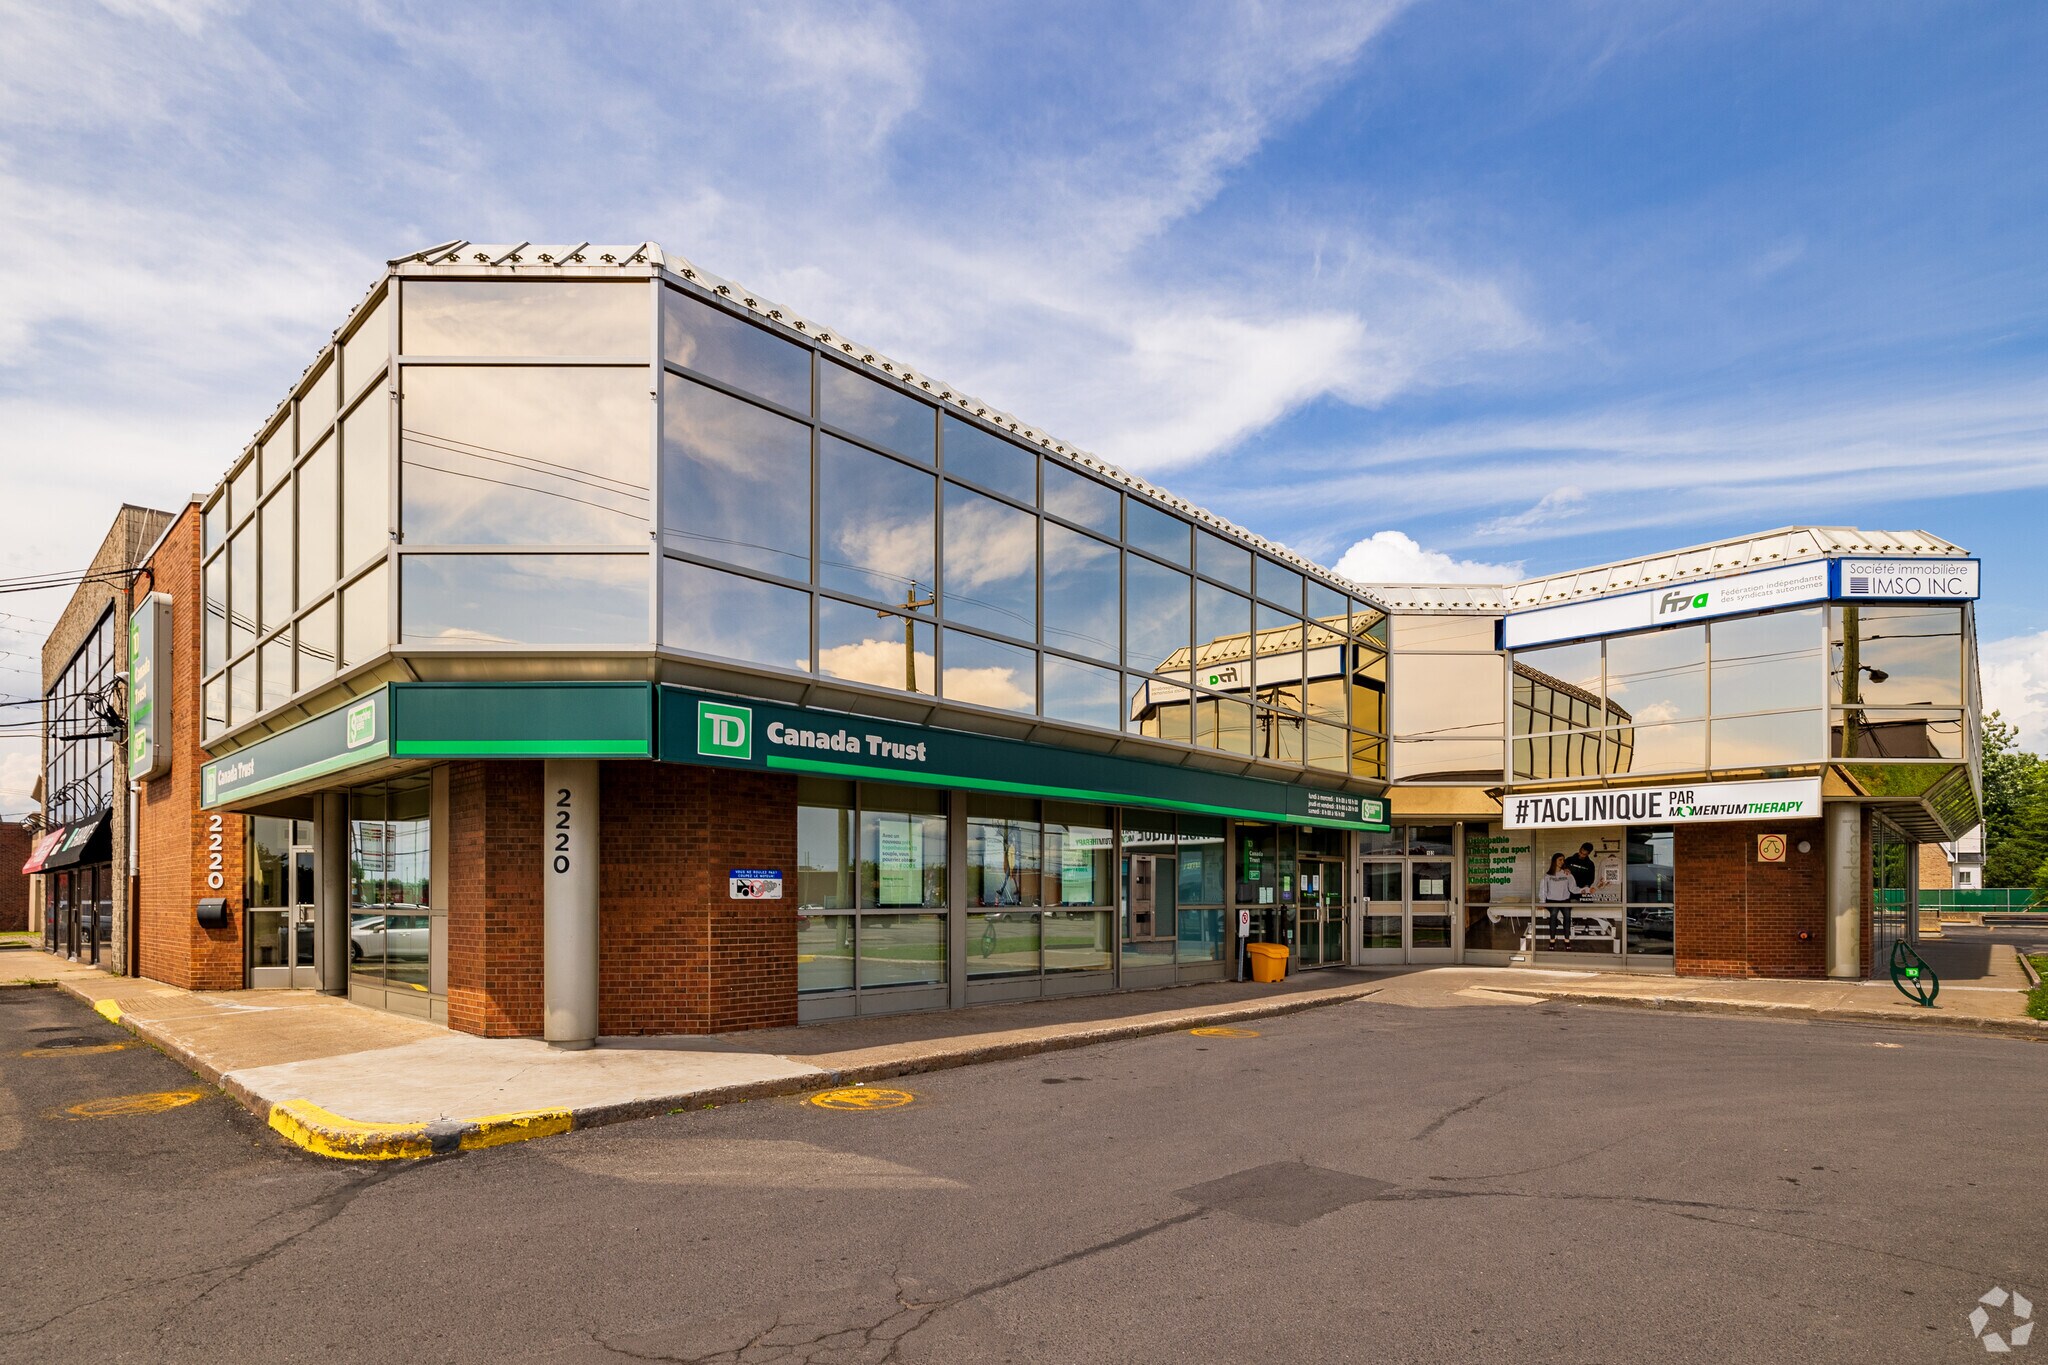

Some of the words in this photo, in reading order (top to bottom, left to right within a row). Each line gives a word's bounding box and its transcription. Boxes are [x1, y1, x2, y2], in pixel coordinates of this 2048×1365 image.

[1850, 563, 1895, 574] Société
[1898, 563, 1968, 574] immobilière
[1720, 584, 1764, 597] Fédération
[1766, 574, 1823, 589] indépendante
[1737, 590, 1774, 602] syndicats
[1776, 581, 1823, 594] autonomes
[1872, 577, 1921, 595] IMSO
[1928, 577, 1968, 595] INC.
[704, 712, 746, 748] TD
[767, 721, 861, 753] Canada
[865, 734, 927, 762] Trust
[218, 763, 238, 786] Canada
[238, 757, 255, 779] Trust
[1515, 792, 1662, 824] #TACLINIQUE
[1669, 790, 1694, 804] PAR
[553, 788, 571, 874] 2220
[207, 814, 224, 889] 2220
[1492, 855, 1516, 865] sportif
[1511, 845, 1530, 854] sport
